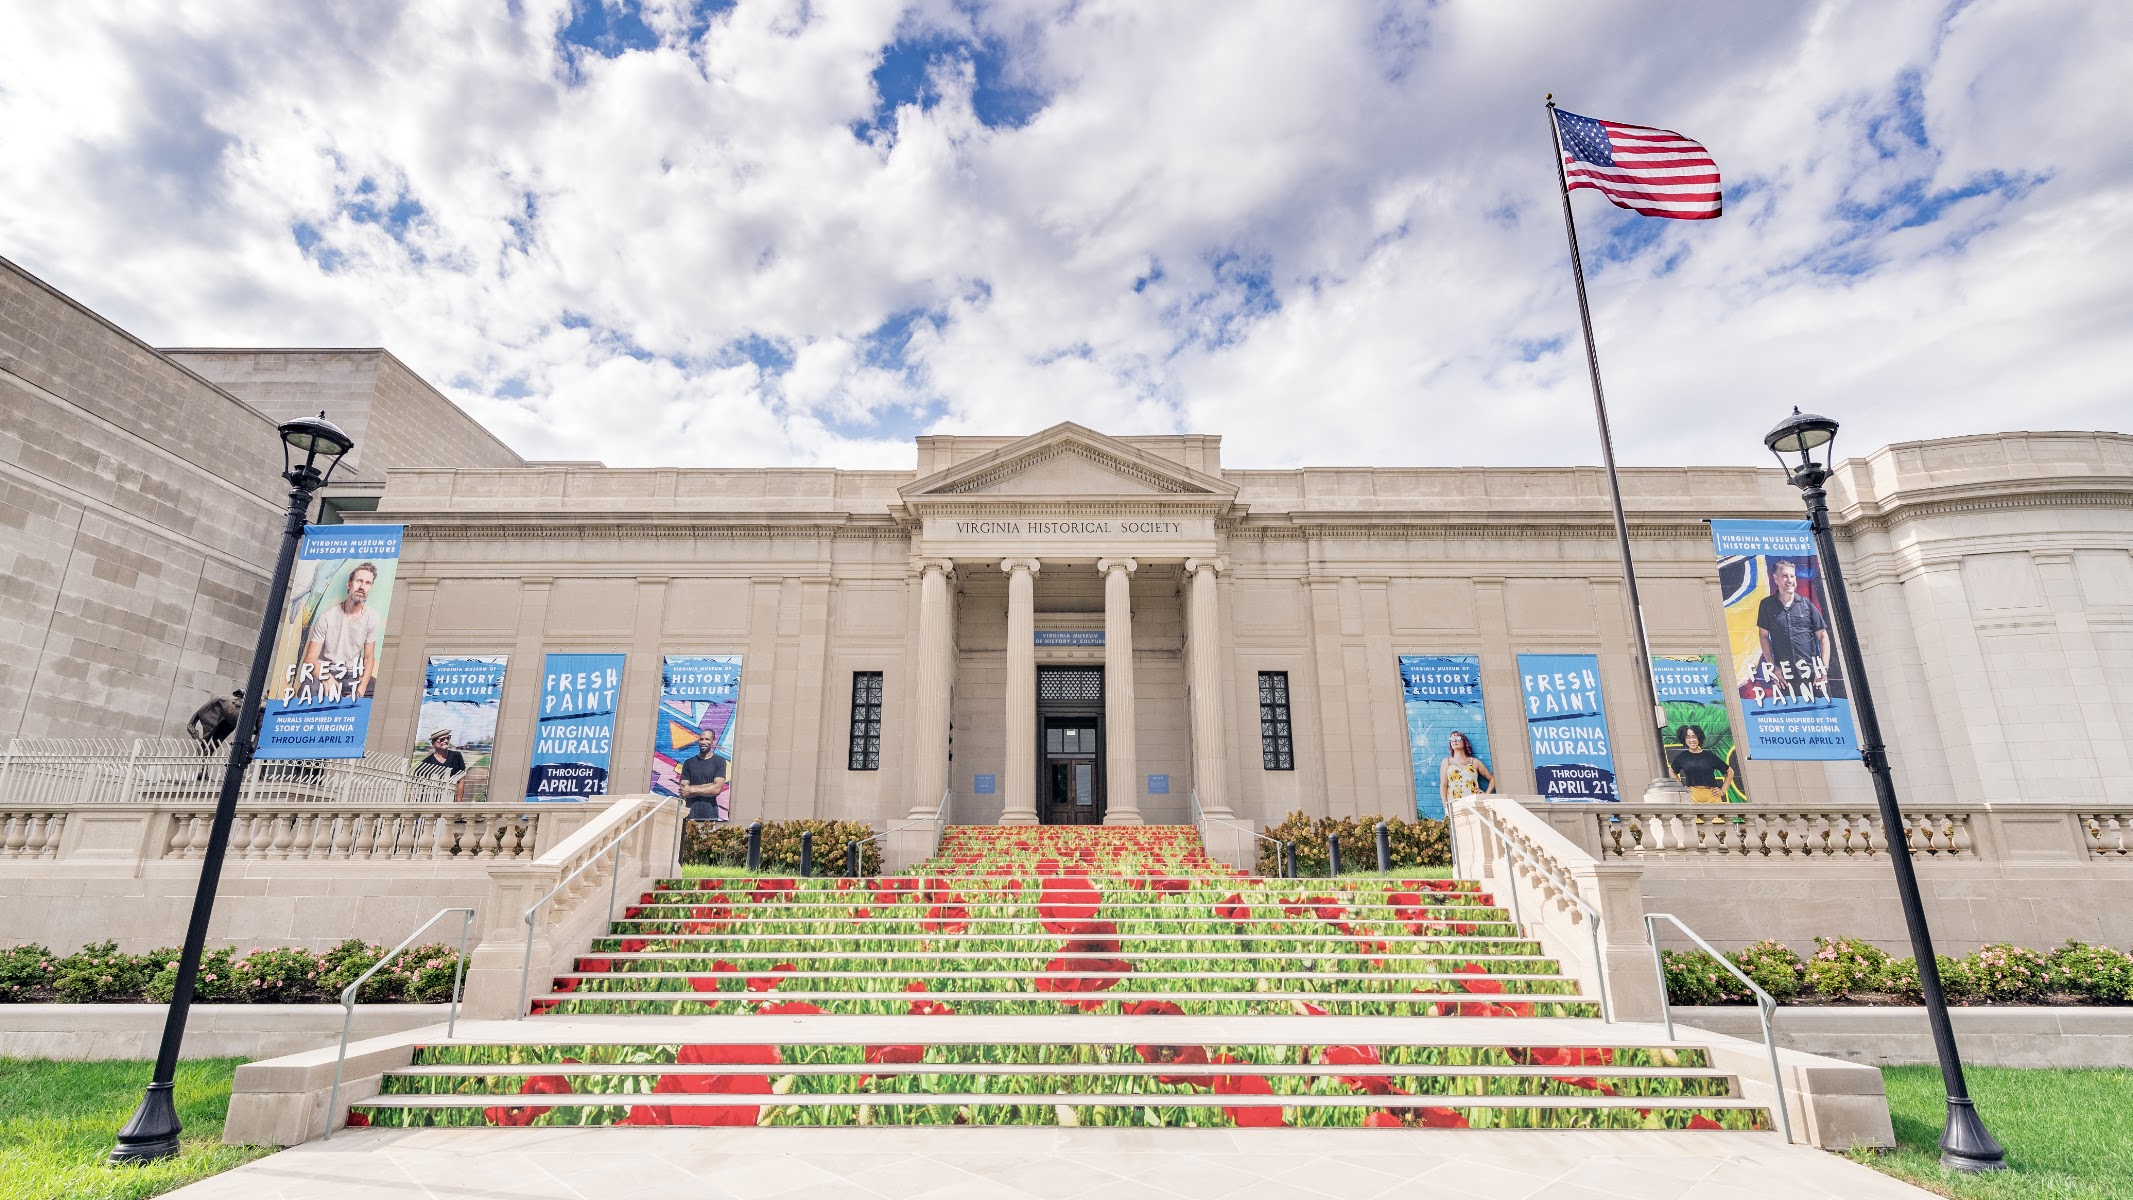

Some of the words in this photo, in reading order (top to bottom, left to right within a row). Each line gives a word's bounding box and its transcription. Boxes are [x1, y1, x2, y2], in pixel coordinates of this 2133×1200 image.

[956, 522, 1020, 534] VIRGINIA
[1027, 522, 1111, 534] HISTORICAL
[1120, 522, 1181, 533] SOCIETY
[1723, 542, 1761, 550] HISTORY
[286, 656, 365, 684] FRESH
[1747, 655, 1828, 683] FRESH
[435, 674, 495, 684] HISTORY
[546, 668, 618, 693] FRESH
[672, 674, 731, 684] HISTORY
[1411, 674, 1470, 684] HISTORY
[1524, 669, 1596, 693] FRESH
[1654, 674, 1709, 684] HISTORY
[283, 680, 361, 708] PAINT
[1752, 680, 1831, 708] PAINT
[545, 689, 615, 714] PAINT
[1528, 691, 1597, 715] PAINT
[541, 725, 610, 738] VIRGINIA
[1532, 726, 1605, 739] VIRGINIA
[1759, 725, 1785, 733] STORY
[1788, 725, 1800, 733] OF
[1801, 725, 1840, 733] VIRGINIA
[271, 736, 316, 744] THROUGH
[318, 736, 342, 744] APRIL
[345, 736, 355, 744] 21
[537, 739, 609, 754] MURALS
[1759, 736, 1806, 745] THROUGH
[1808, 736, 1834, 745] APRIL
[1835, 736, 1845, 745] 21
[1535, 740, 1607, 755] MURALS
[547, 768, 594, 777] THROUGH
[1551, 769, 1599, 779] THROUGH
[537, 779, 579, 793] APRIL
[583, 779, 599, 793] 21
[1547, 781, 1590, 794] APRIL
[1593, 781, 1609, 794] 21
